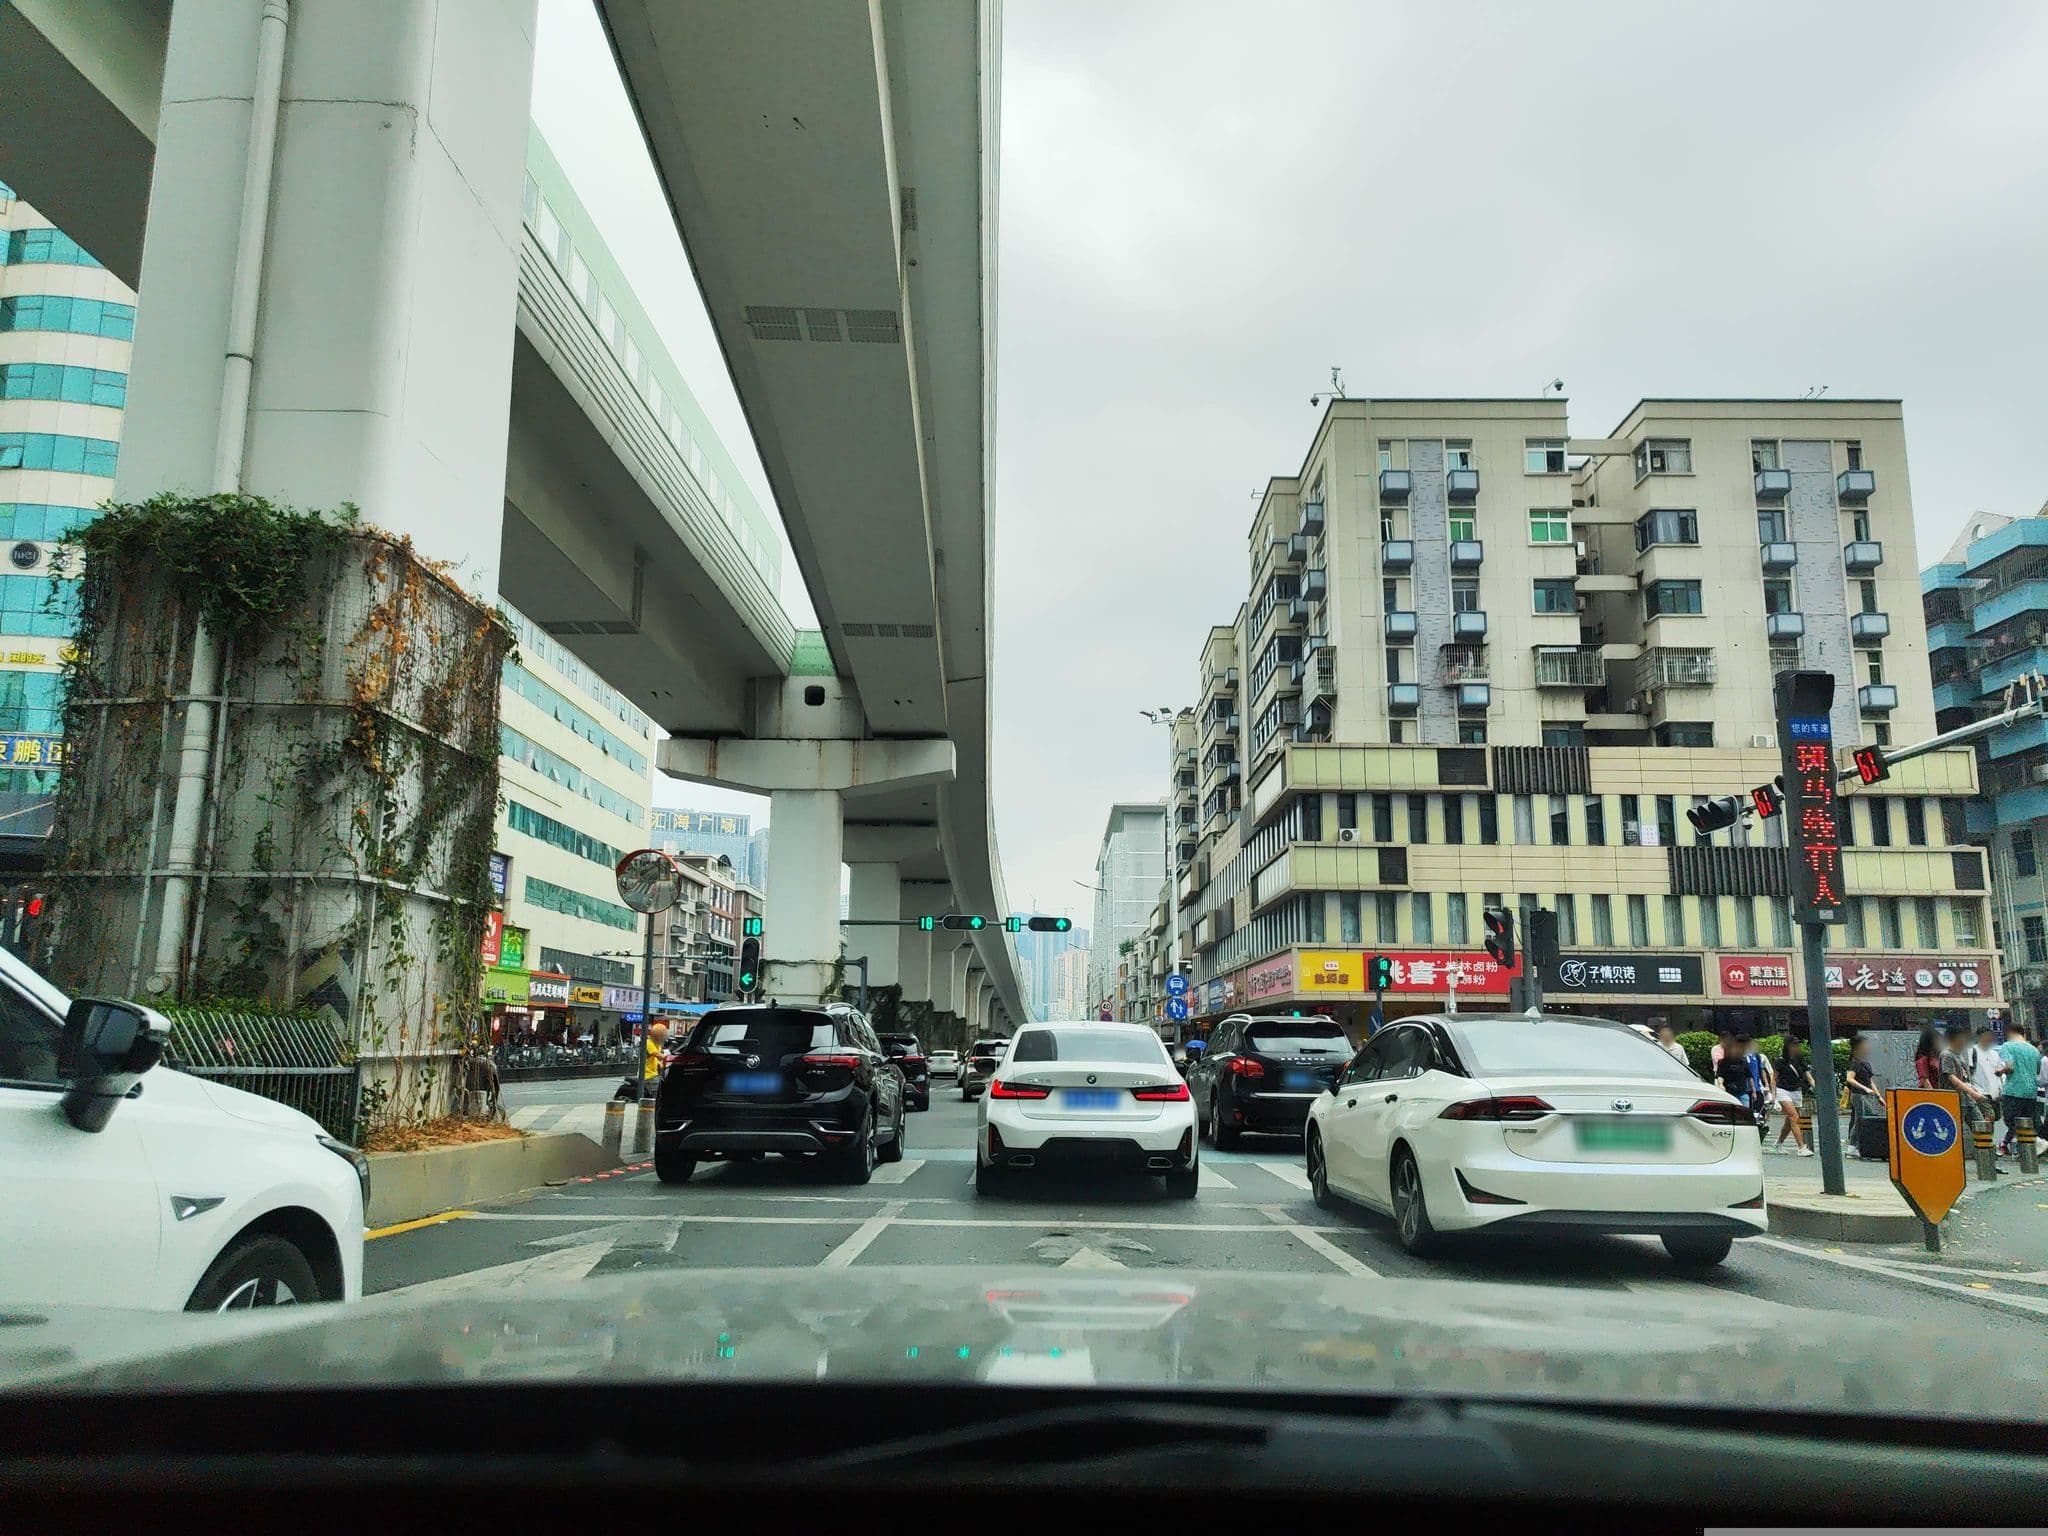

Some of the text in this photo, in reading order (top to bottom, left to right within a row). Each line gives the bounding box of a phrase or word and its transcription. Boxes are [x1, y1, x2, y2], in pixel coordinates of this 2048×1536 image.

[1791, 722, 1830, 734] 您的车速
[1588, 965, 1635, 980] 子情贝诺
[1748, 965, 1788, 979] 美宜佳
[1847, 963, 1906, 991] 老上海
